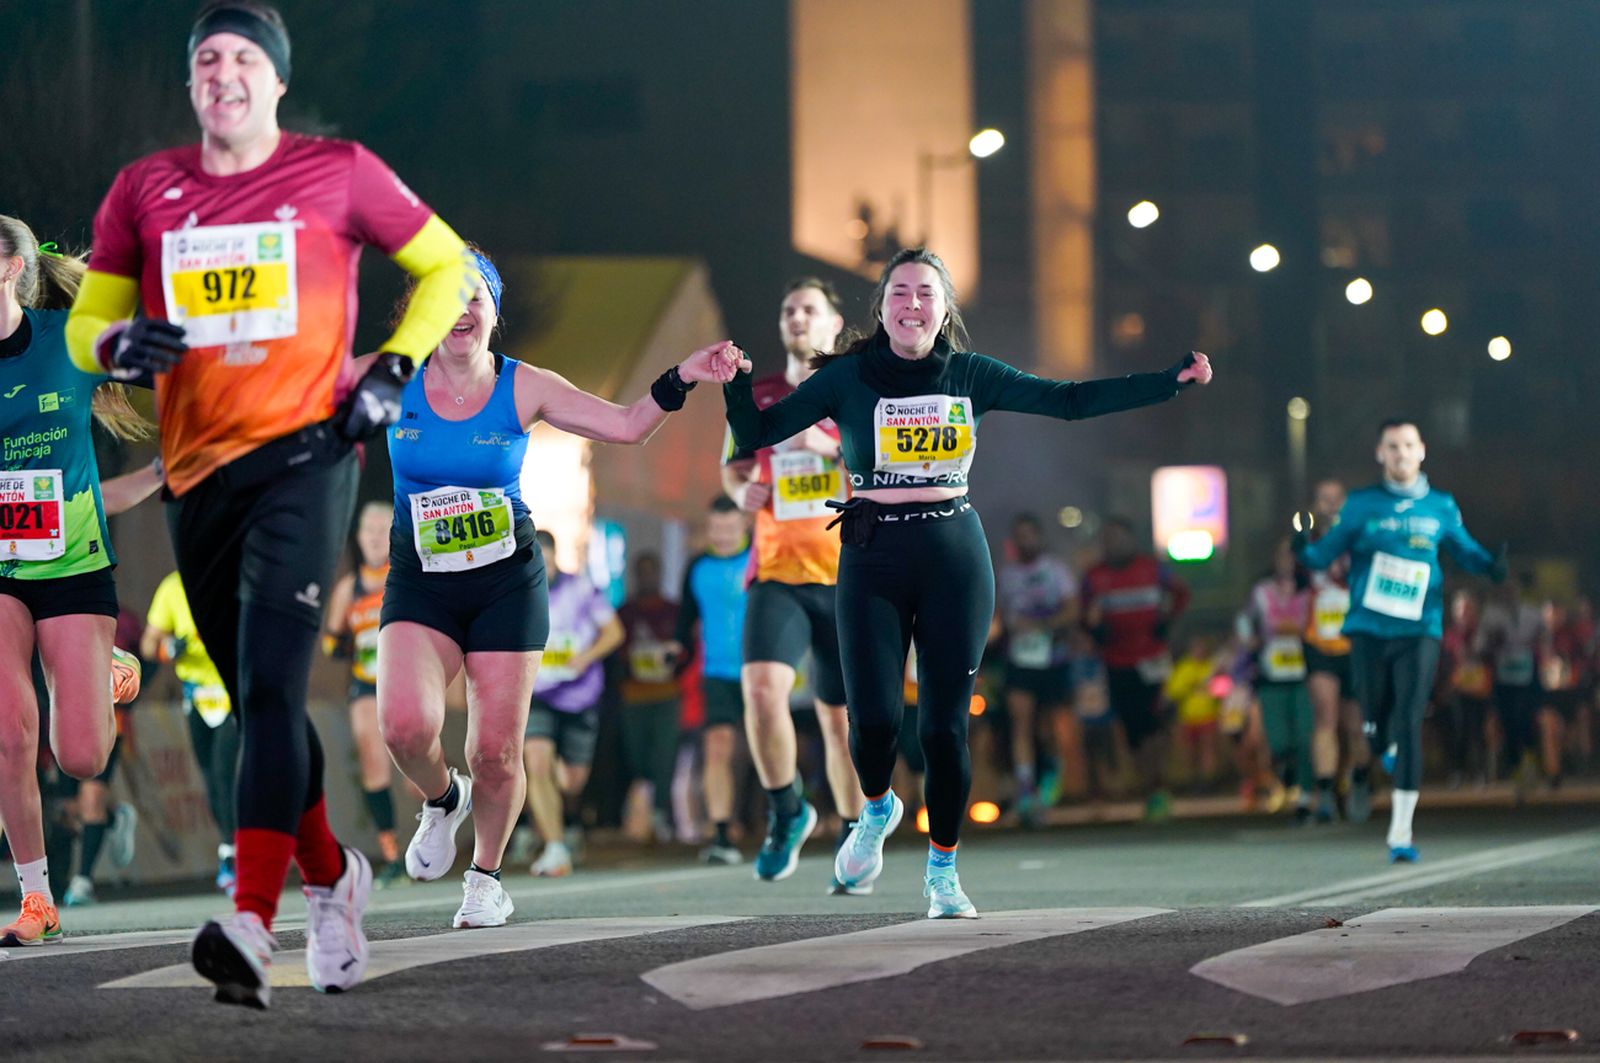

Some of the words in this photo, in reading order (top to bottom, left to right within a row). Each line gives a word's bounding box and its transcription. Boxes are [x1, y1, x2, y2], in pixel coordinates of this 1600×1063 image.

[202, 266, 257, 303] 972
[896, 405, 926, 416] NOCHE
[927, 405, 939, 414] DE
[886, 417, 906, 427] SAN
[907, 414, 940, 426] ANTÓN
[3, 426, 68, 449] Fundación
[896, 426, 957, 453] 5278
[4, 443, 52, 461] Unicaja
[13, 480, 25, 490] DE
[788, 473, 830, 495] 5607
[849, 473, 864, 486] O
[873, 473, 928, 486] NIKE
[934, 470, 968, 484] PRO
[431, 495, 460, 508] NOCHE
[460, 491, 472, 502] DE
[0, 503, 43, 530] 021
[423, 509, 442, 521] SAN
[443, 502, 474, 516] ANTÓN
[434, 510, 495, 545] 8416
